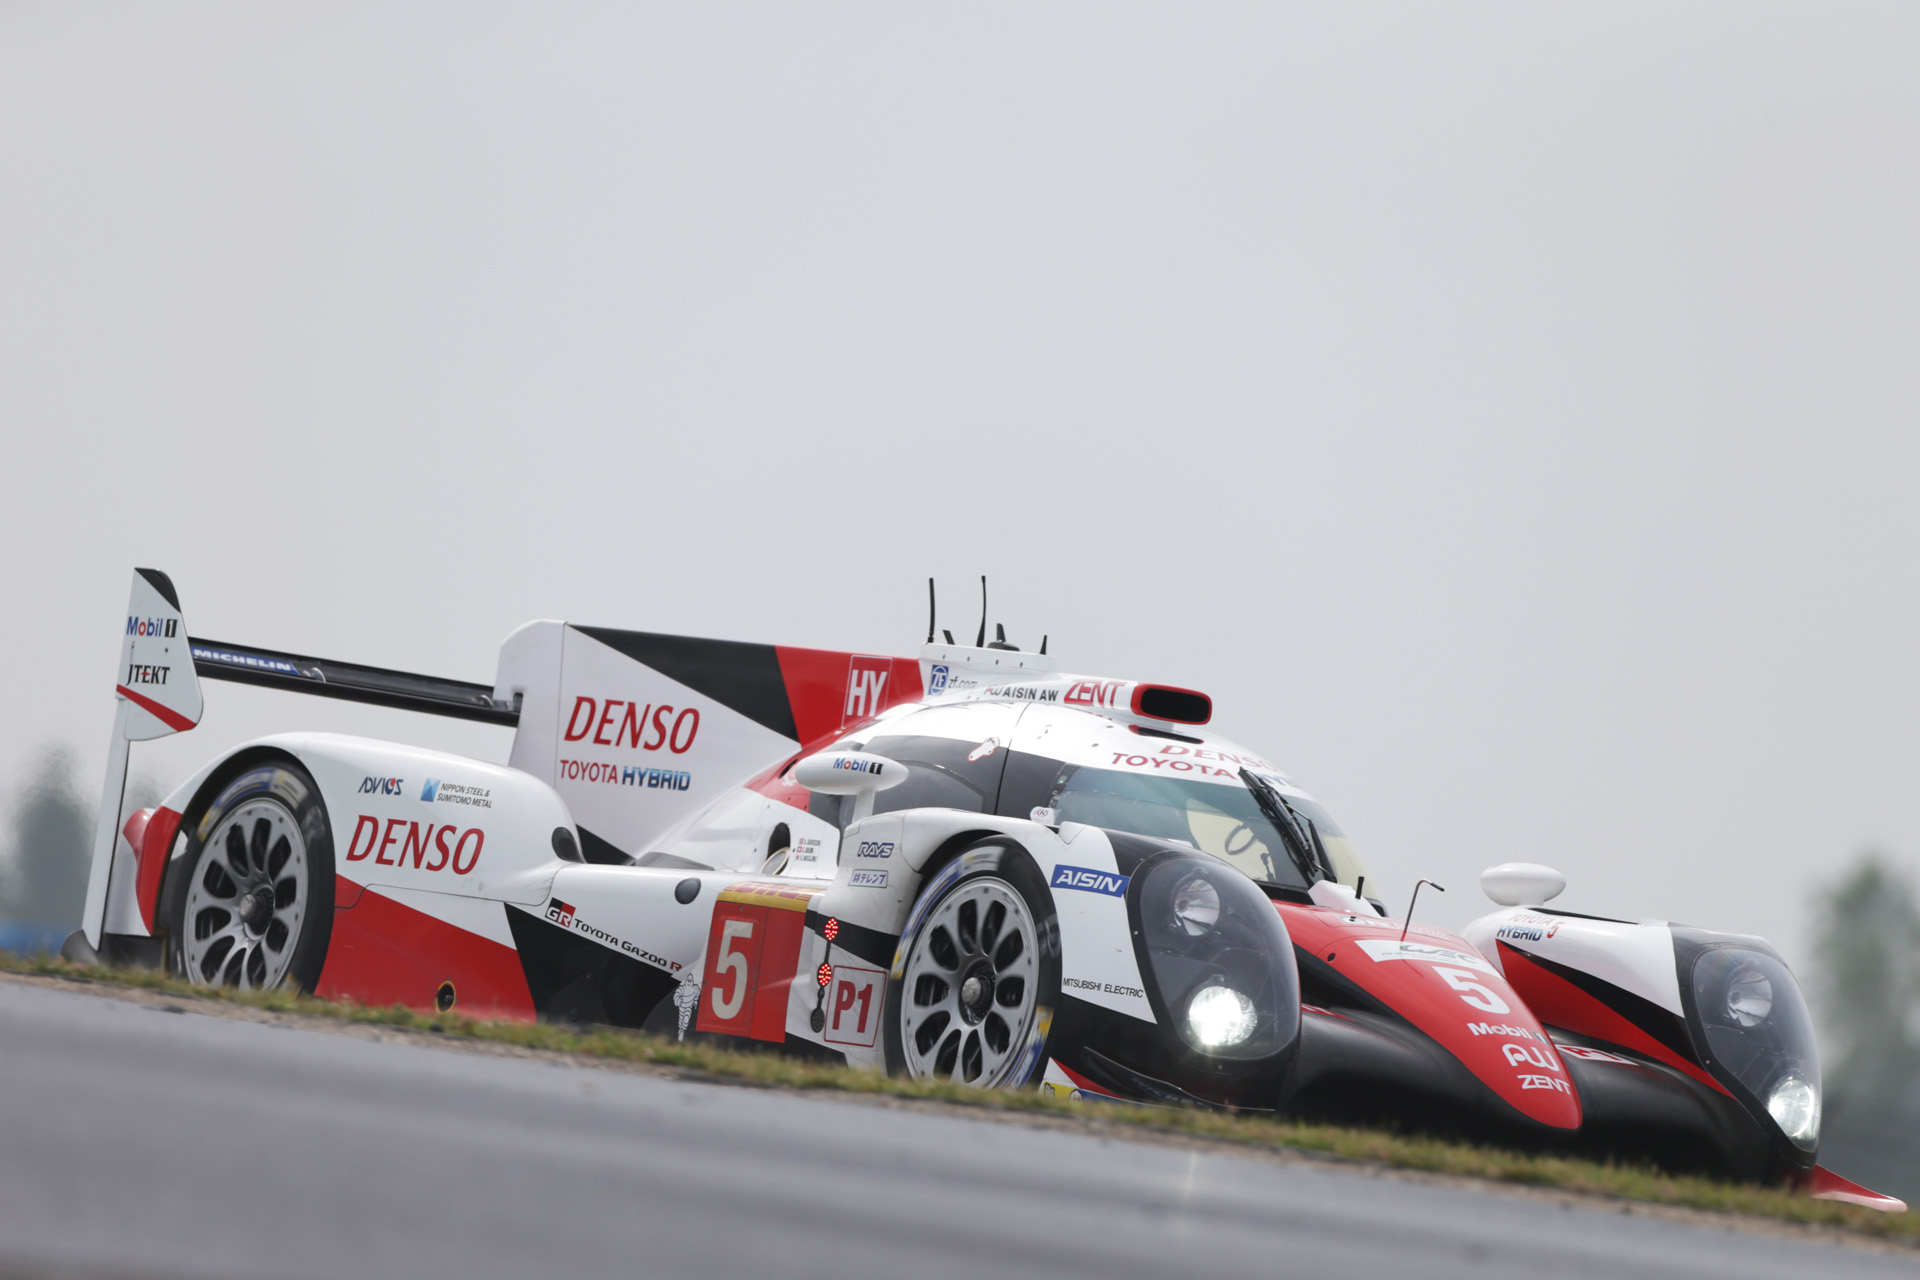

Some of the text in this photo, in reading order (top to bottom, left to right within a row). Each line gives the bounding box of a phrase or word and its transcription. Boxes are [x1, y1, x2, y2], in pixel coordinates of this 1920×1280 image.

[126, 616, 178, 638] Mobil 1
[193, 649, 291, 671] MICHELIN
[126, 664, 170, 686] JTEKT
[948, 676, 978, 689] zf.com
[846, 669, 888, 717] HY
[1003, 685, 1037, 700] AISIN
[1038, 688, 1060, 702] AW
[1064, 680, 1127, 708] ZENT
[564, 696, 700, 754] DENSO
[833, 758, 883, 775] Mobil 1
[1112, 752, 1238, 780] TOYOTA
[1159, 744, 1279, 773] DENSO
[358, 777, 404, 795] ADVICS
[560, 759, 691, 791] TOYOTA HYBRID
[437, 793, 492, 808] SUMITOMO METAL
[440, 783, 490, 797] NIPPON STEEL &
[346, 815, 485, 875] DENSO
[857, 842, 894, 858] RAYS
[1056, 870, 1122, 892] AISIN
[545, 905, 574, 928] GR
[1508, 913, 1555, 926] TOYOTA
[574, 918, 619, 946] TOYOTA
[621, 941, 668, 967] GAZOO
[1497, 925, 1544, 941] HYBRID
[711, 920, 754, 1019] 5
[1062, 978, 1144, 998] MITSUBISHI ELECTRIC
[1432, 966, 1510, 1014] 5
[832, 980, 873, 1023] P1
[1467, 1022, 1532, 1040] Mobil
[1517, 1075, 1571, 1095] ZENT
